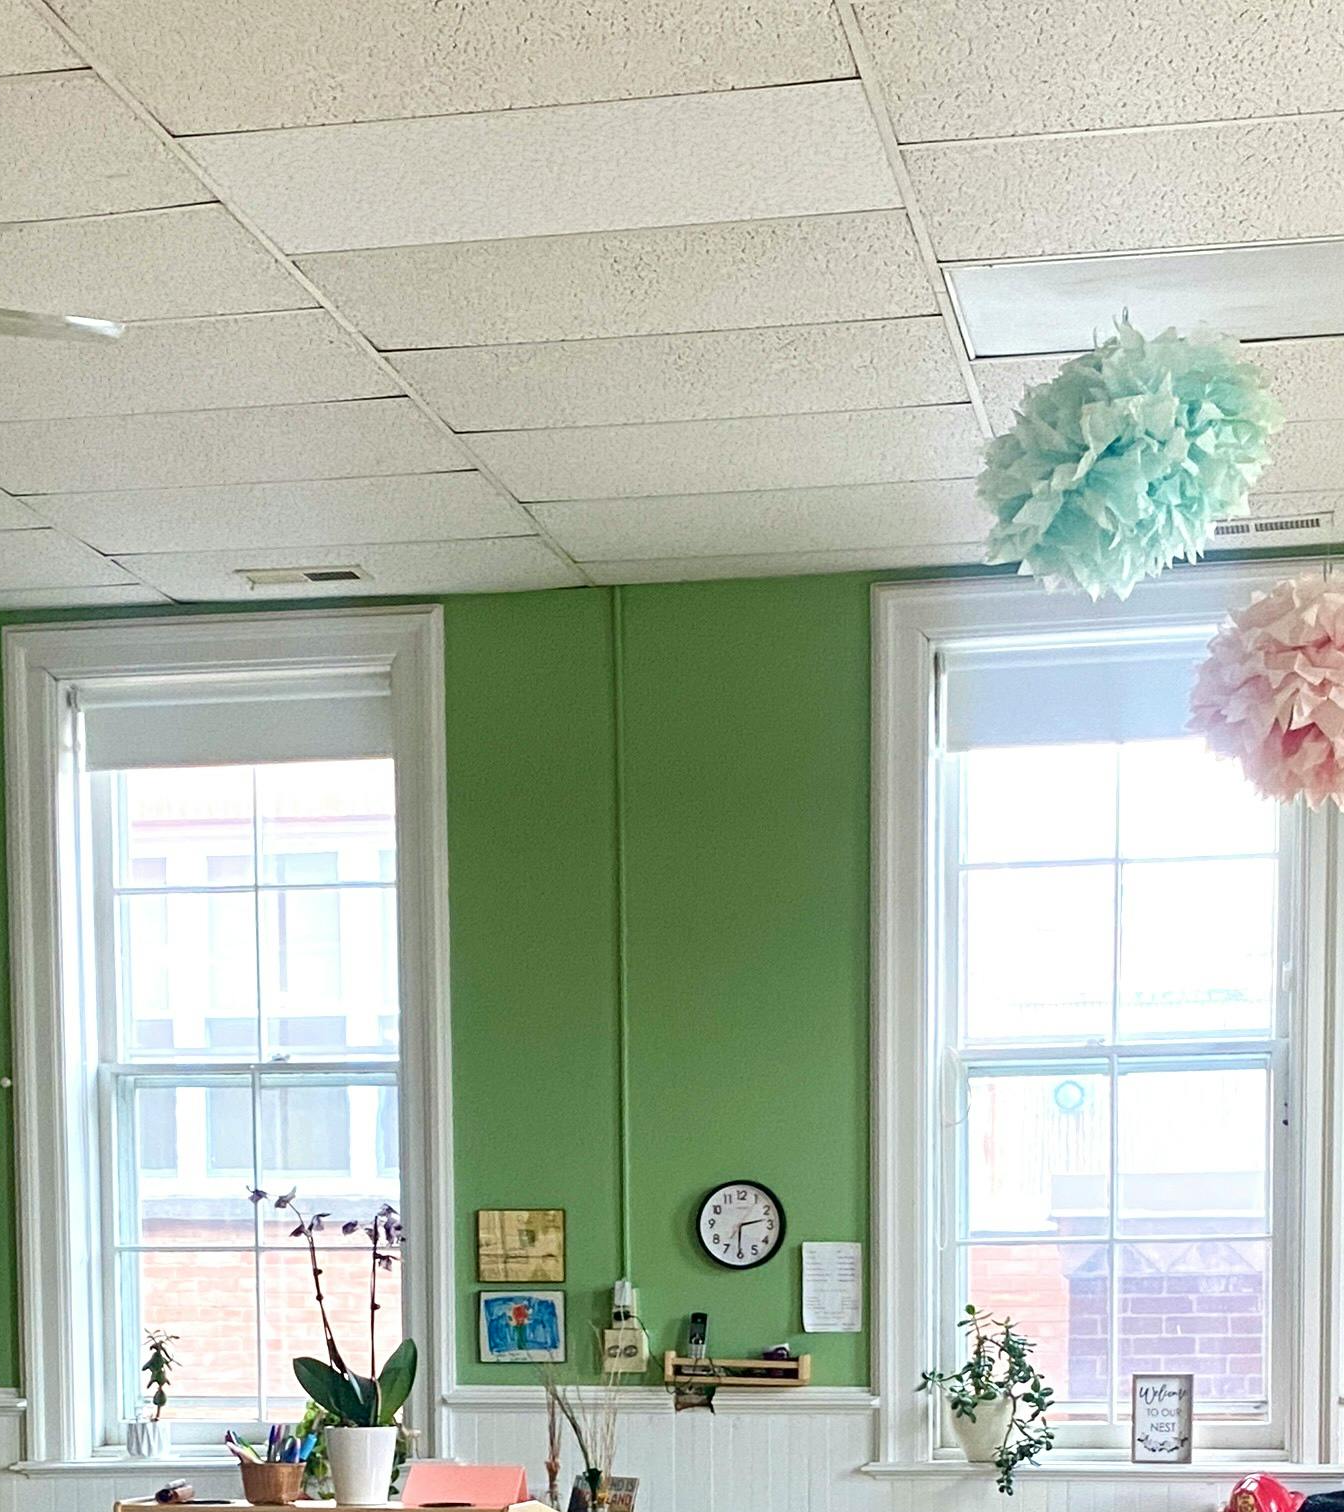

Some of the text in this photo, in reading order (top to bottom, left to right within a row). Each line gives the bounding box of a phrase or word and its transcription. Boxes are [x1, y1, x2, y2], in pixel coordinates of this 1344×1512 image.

[723, 1193, 732, 1204] 11
[736, 1190, 748, 1201] 12
[753, 1194, 758, 1204] 1
[712, 1205, 722, 1215] 10
[762, 1205, 771, 1216] 2
[708, 1218, 716, 1229] 9
[766, 1219, 774, 1231] 3
[712, 1233, 720, 1245] 8
[761, 1235, 769, 1245] 4
[723, 1243, 731, 1254] 7
[736, 1247, 744, 1259] 6
[751, 1244, 759, 1256] 5
[1146, 1408, 1182, 1418] TO OUR
[1150, 1422, 1176, 1433] NEST
